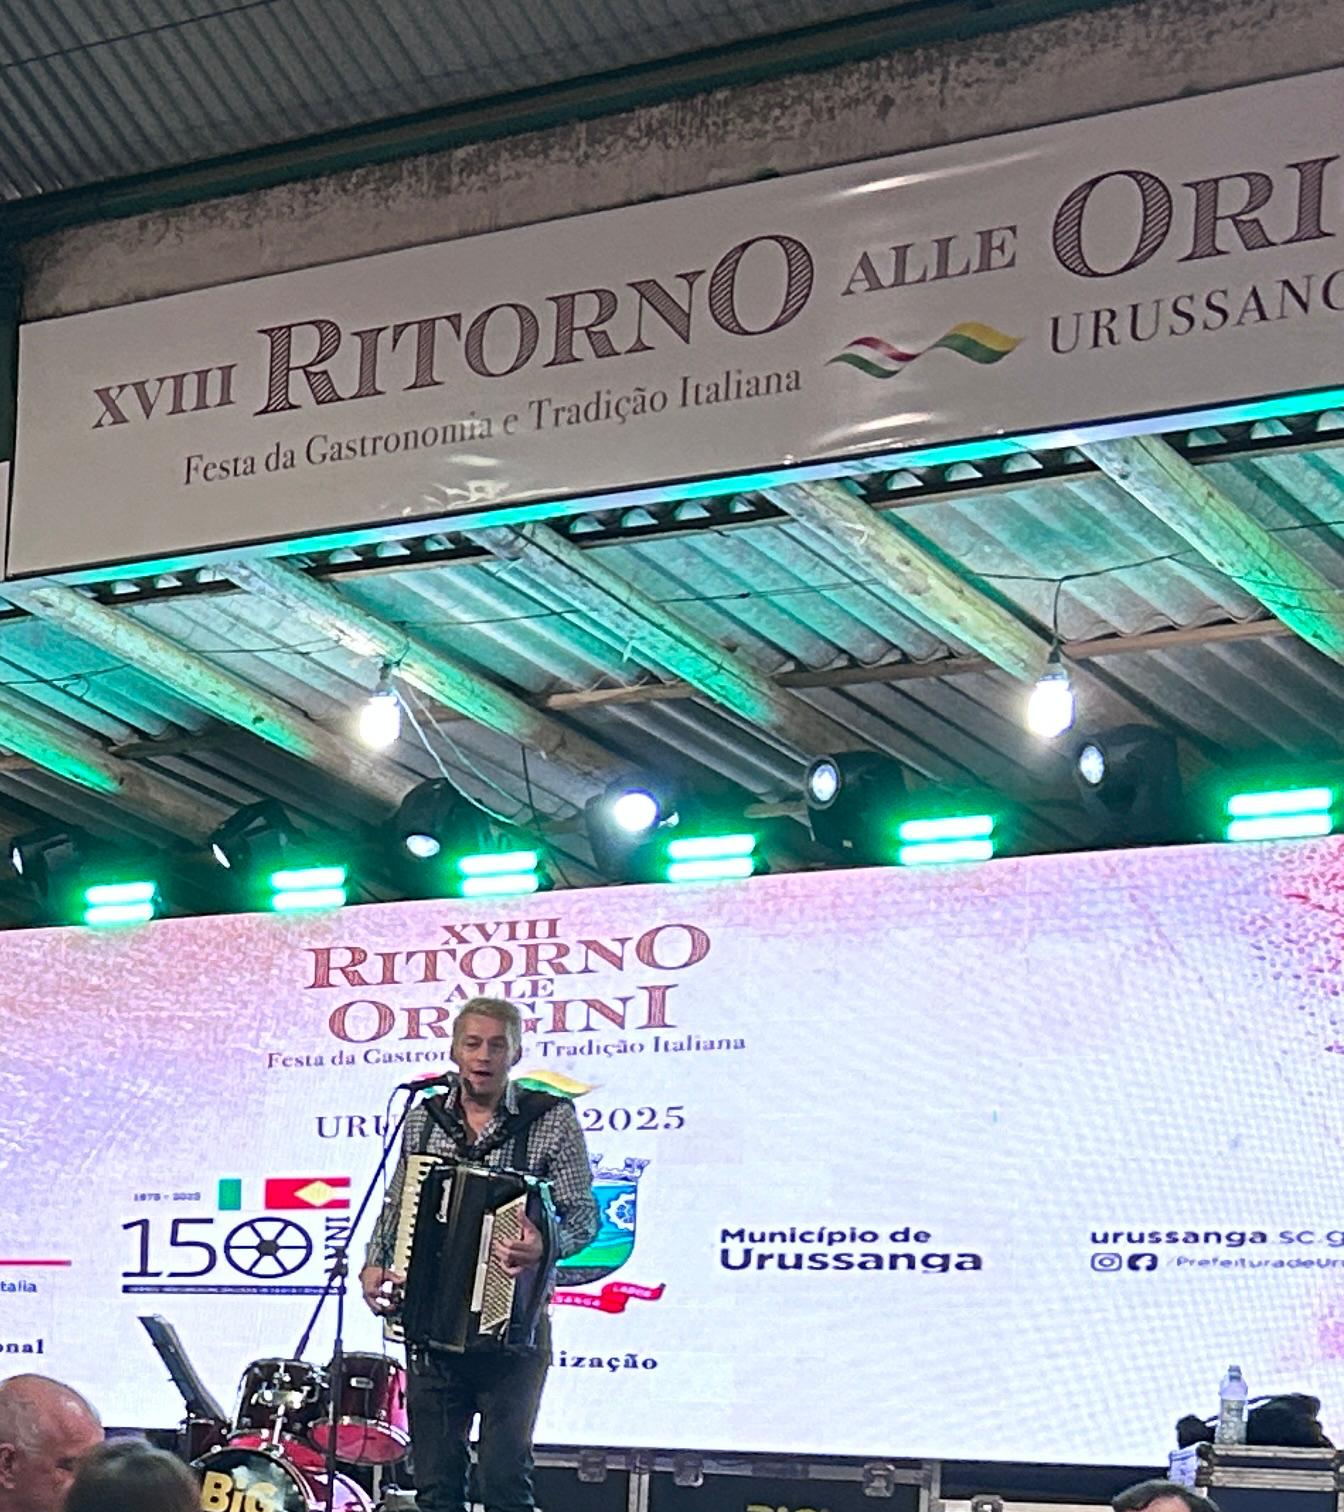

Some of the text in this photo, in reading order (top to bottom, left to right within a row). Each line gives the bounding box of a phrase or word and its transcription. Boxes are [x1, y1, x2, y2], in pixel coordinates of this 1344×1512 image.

[92, 362, 238, 429] XVIII
[253, 233, 814, 418] RITORNO
[841, 225, 1019, 297] ALLE
[183, 368, 802, 486] Festa da Gastronomia e Tradição Italiana
[440, 917, 564, 946] XVIII
[303, 922, 712, 990] RITORNO
[267, 1050, 326, 1070] Festa
[330, 1049, 357, 1068] da
[535, 1039, 645, 1060] Tradição
[653, 1034, 747, 1053] Italiana
[582, 1105, 686, 1132] 2025
[720, 1225, 932, 1247] Município de
[719, 1246, 985, 1275] Urussanga
